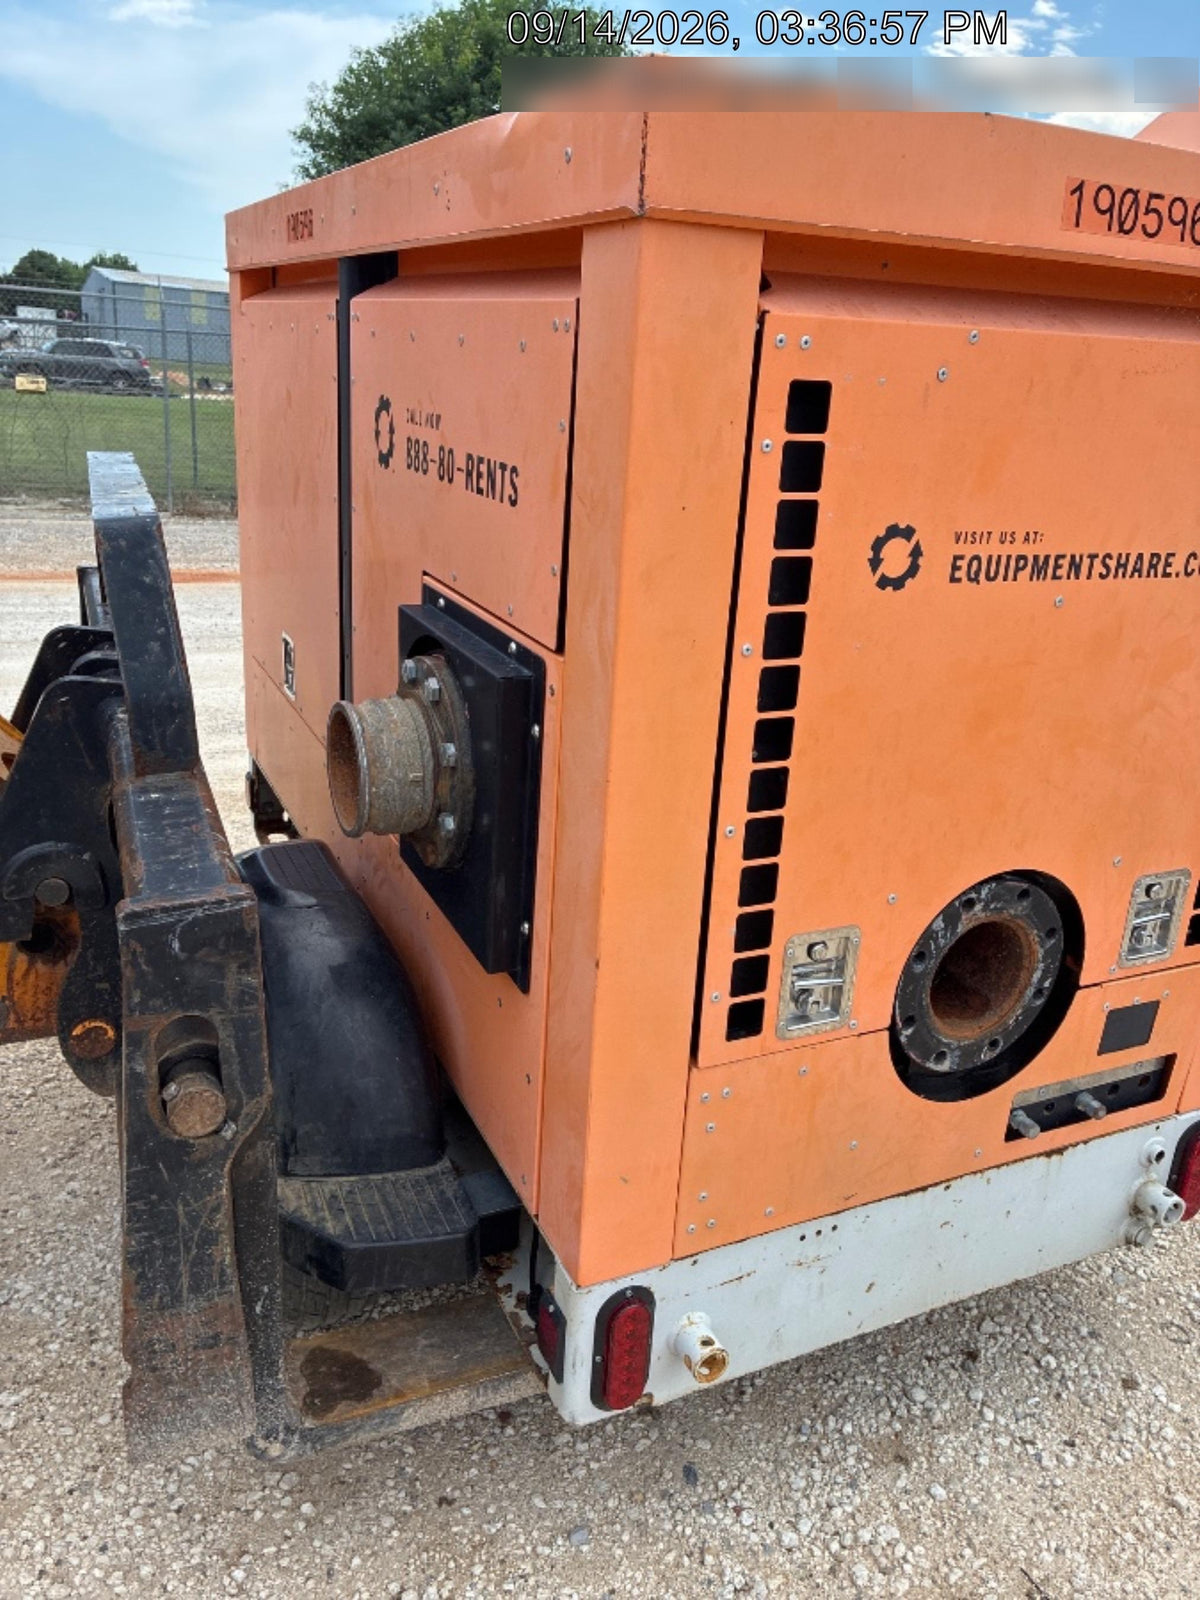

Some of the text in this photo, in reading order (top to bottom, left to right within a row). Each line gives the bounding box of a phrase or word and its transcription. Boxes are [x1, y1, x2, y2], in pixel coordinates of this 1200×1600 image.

[954, 530, 1045, 545] VISIT US AT:
[949, 551, 1200, 585] EQUIPMENTSHARE.C
